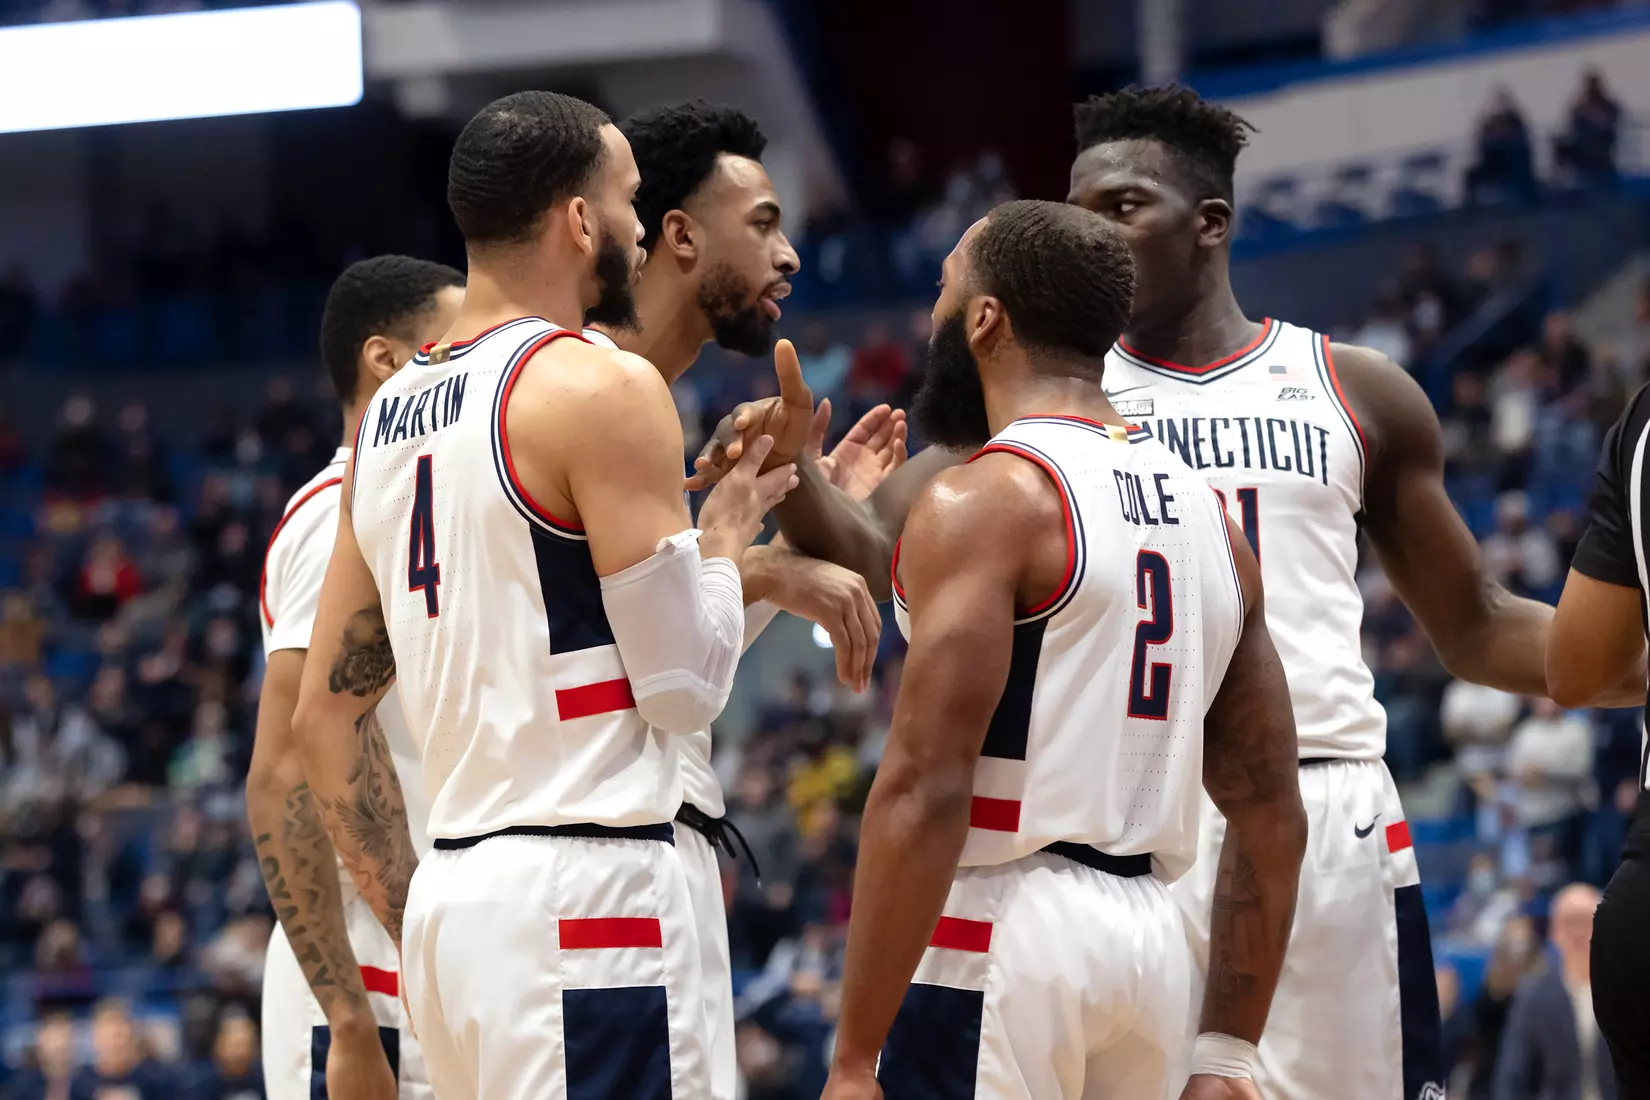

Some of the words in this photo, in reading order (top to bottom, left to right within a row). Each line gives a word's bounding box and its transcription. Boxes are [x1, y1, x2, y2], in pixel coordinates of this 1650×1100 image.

[373, 372, 468, 447] MARTIN
[1131, 417, 1330, 486] NECTICUT
[408, 454, 440, 618] 4
[1113, 469, 1179, 525] COLE
[1215, 487, 1262, 568] 1
[1127, 549, 1173, 720] 2
